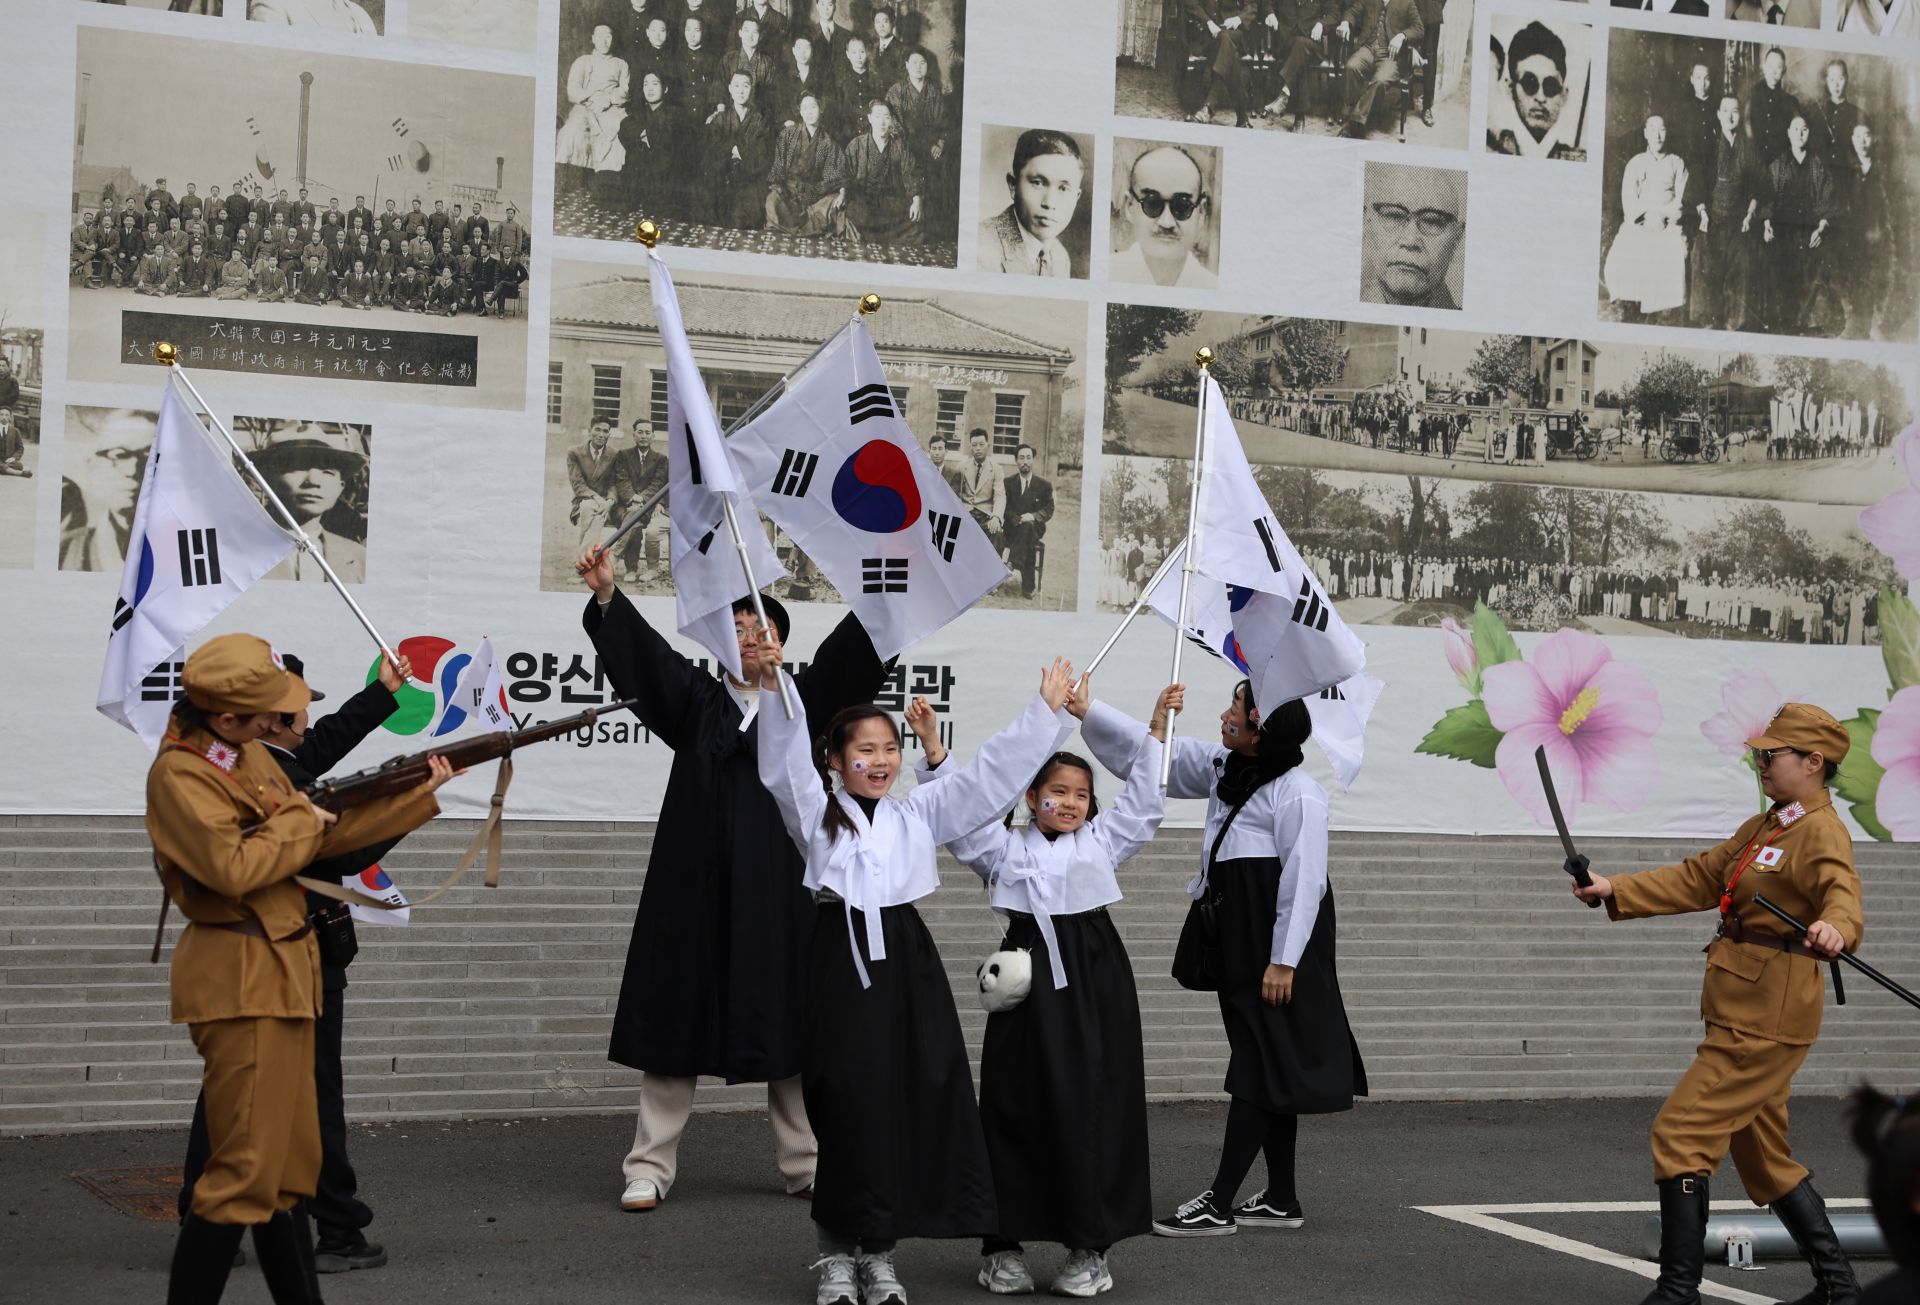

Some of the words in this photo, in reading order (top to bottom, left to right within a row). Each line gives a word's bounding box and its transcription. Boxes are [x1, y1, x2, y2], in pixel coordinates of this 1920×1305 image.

[127, 339, 472, 381] 大國臨時政府新年祝賀會紀念撮影
